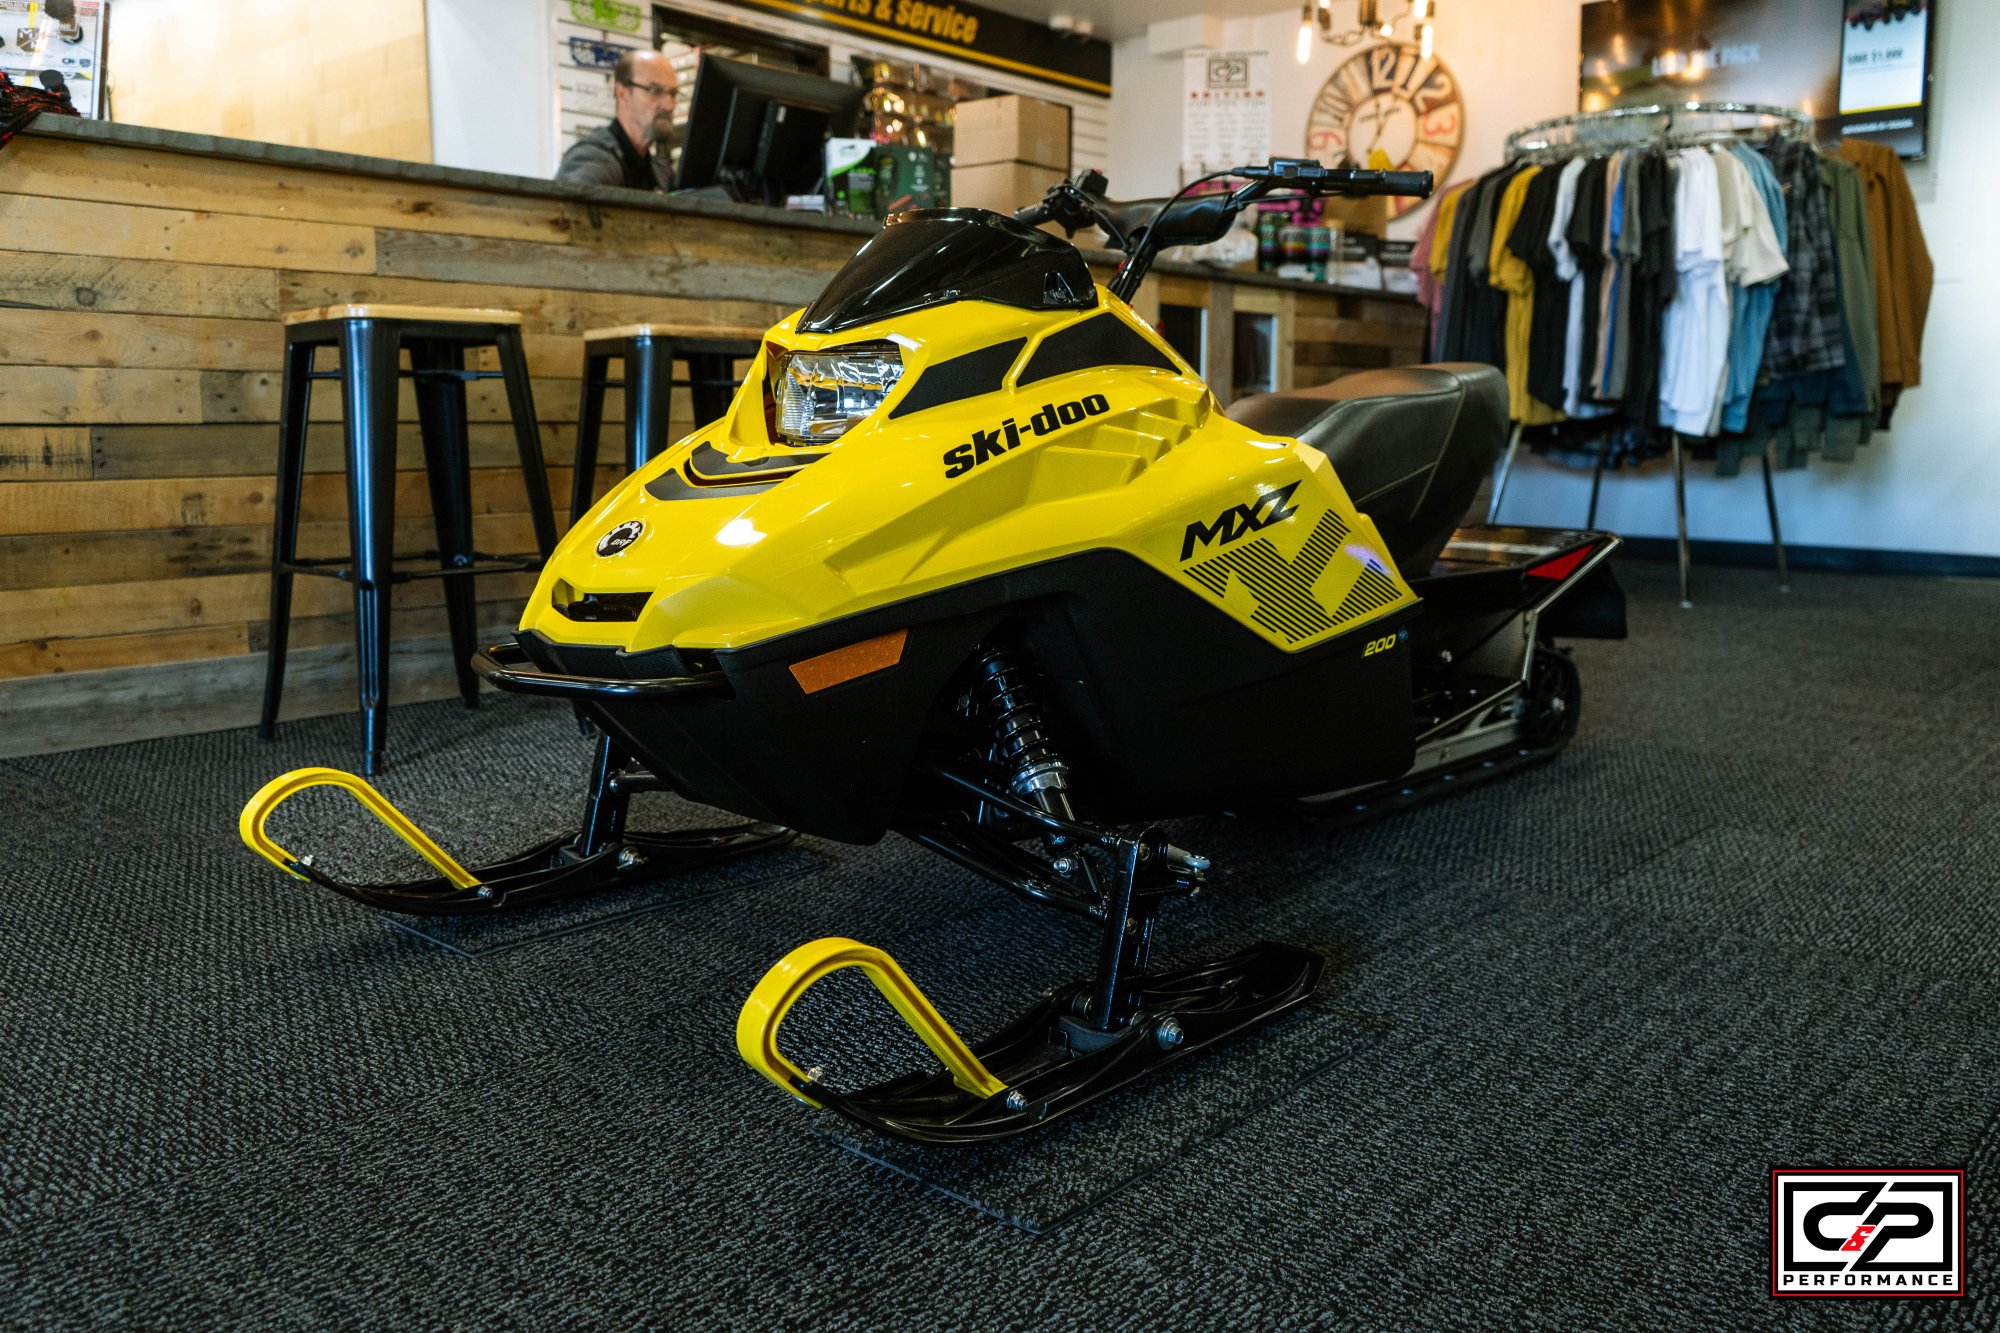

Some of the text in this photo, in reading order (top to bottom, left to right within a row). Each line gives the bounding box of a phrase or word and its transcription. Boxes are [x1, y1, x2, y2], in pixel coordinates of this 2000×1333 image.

[895, 0, 979, 44] service
[943, 393, 1110, 479] ski-doo
[1179, 479, 1303, 562] MXZ
[1362, 633, 1397, 658] 200
